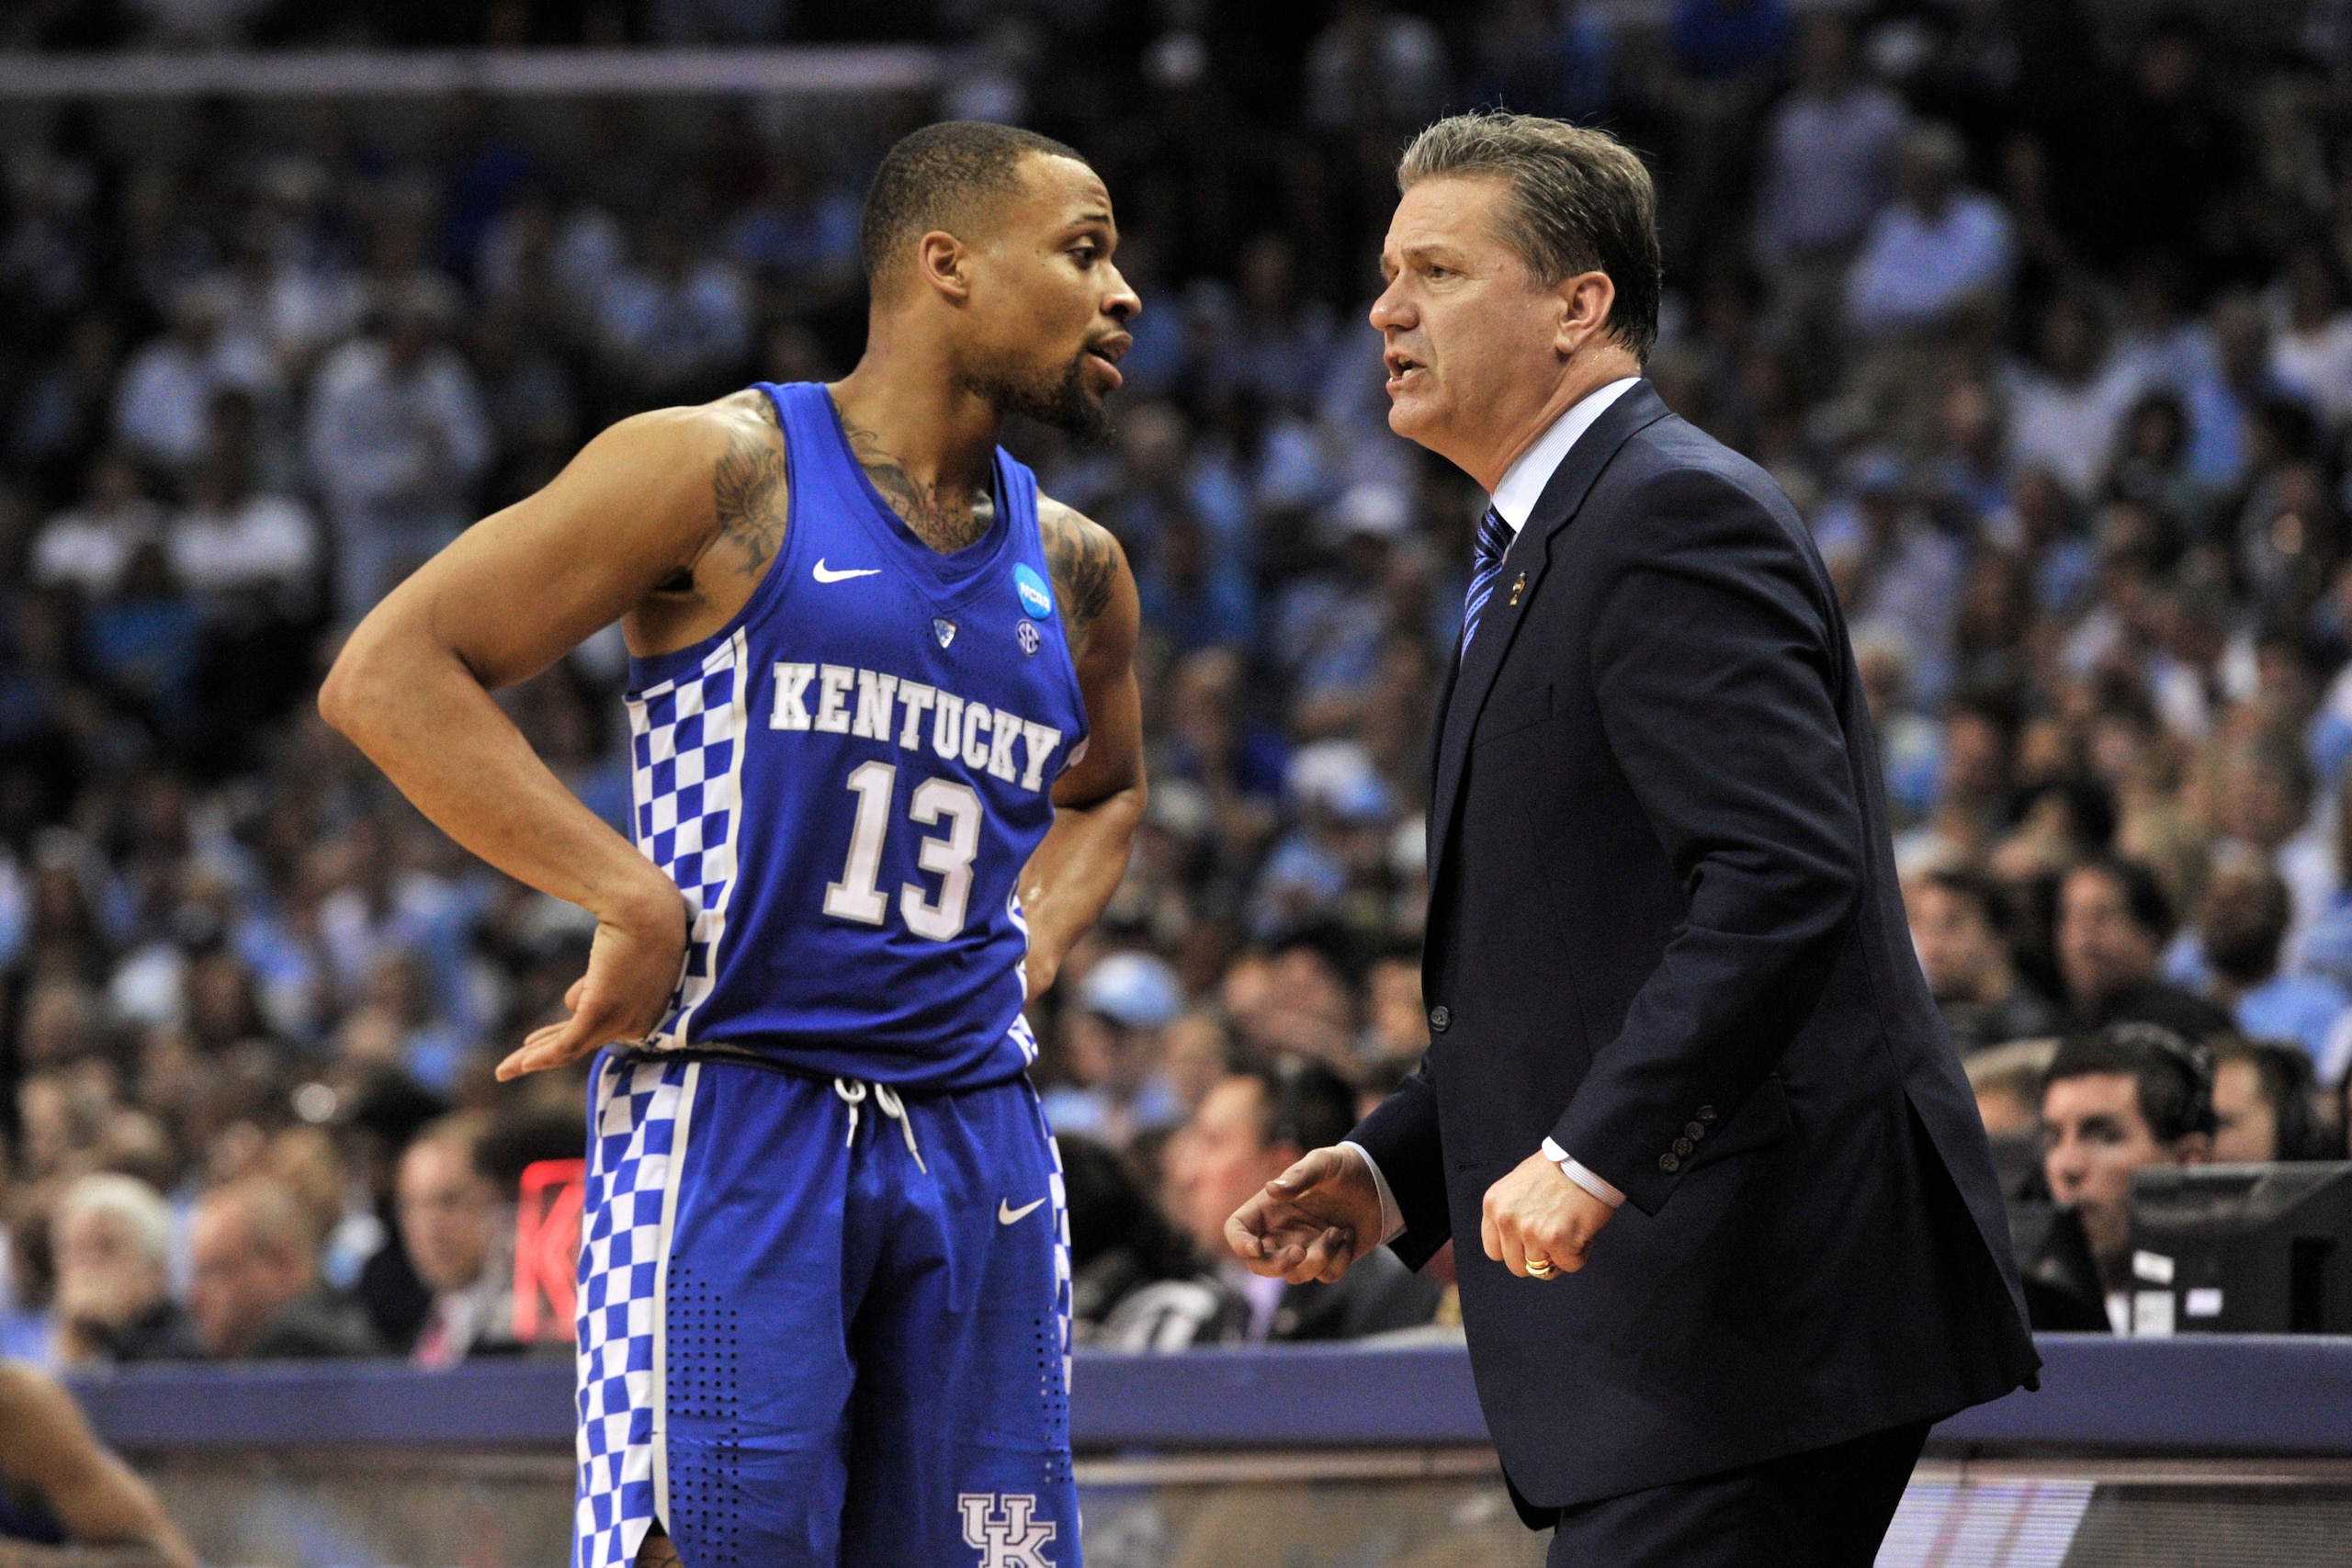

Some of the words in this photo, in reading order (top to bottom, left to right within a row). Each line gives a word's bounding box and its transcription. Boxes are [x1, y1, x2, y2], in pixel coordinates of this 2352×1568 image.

[1018, 622, 1040, 654] SEC
[769, 661, 1062, 793] KENTUCKY
[822, 760, 983, 943] 13
[957, 1493, 1056, 1568] UK
